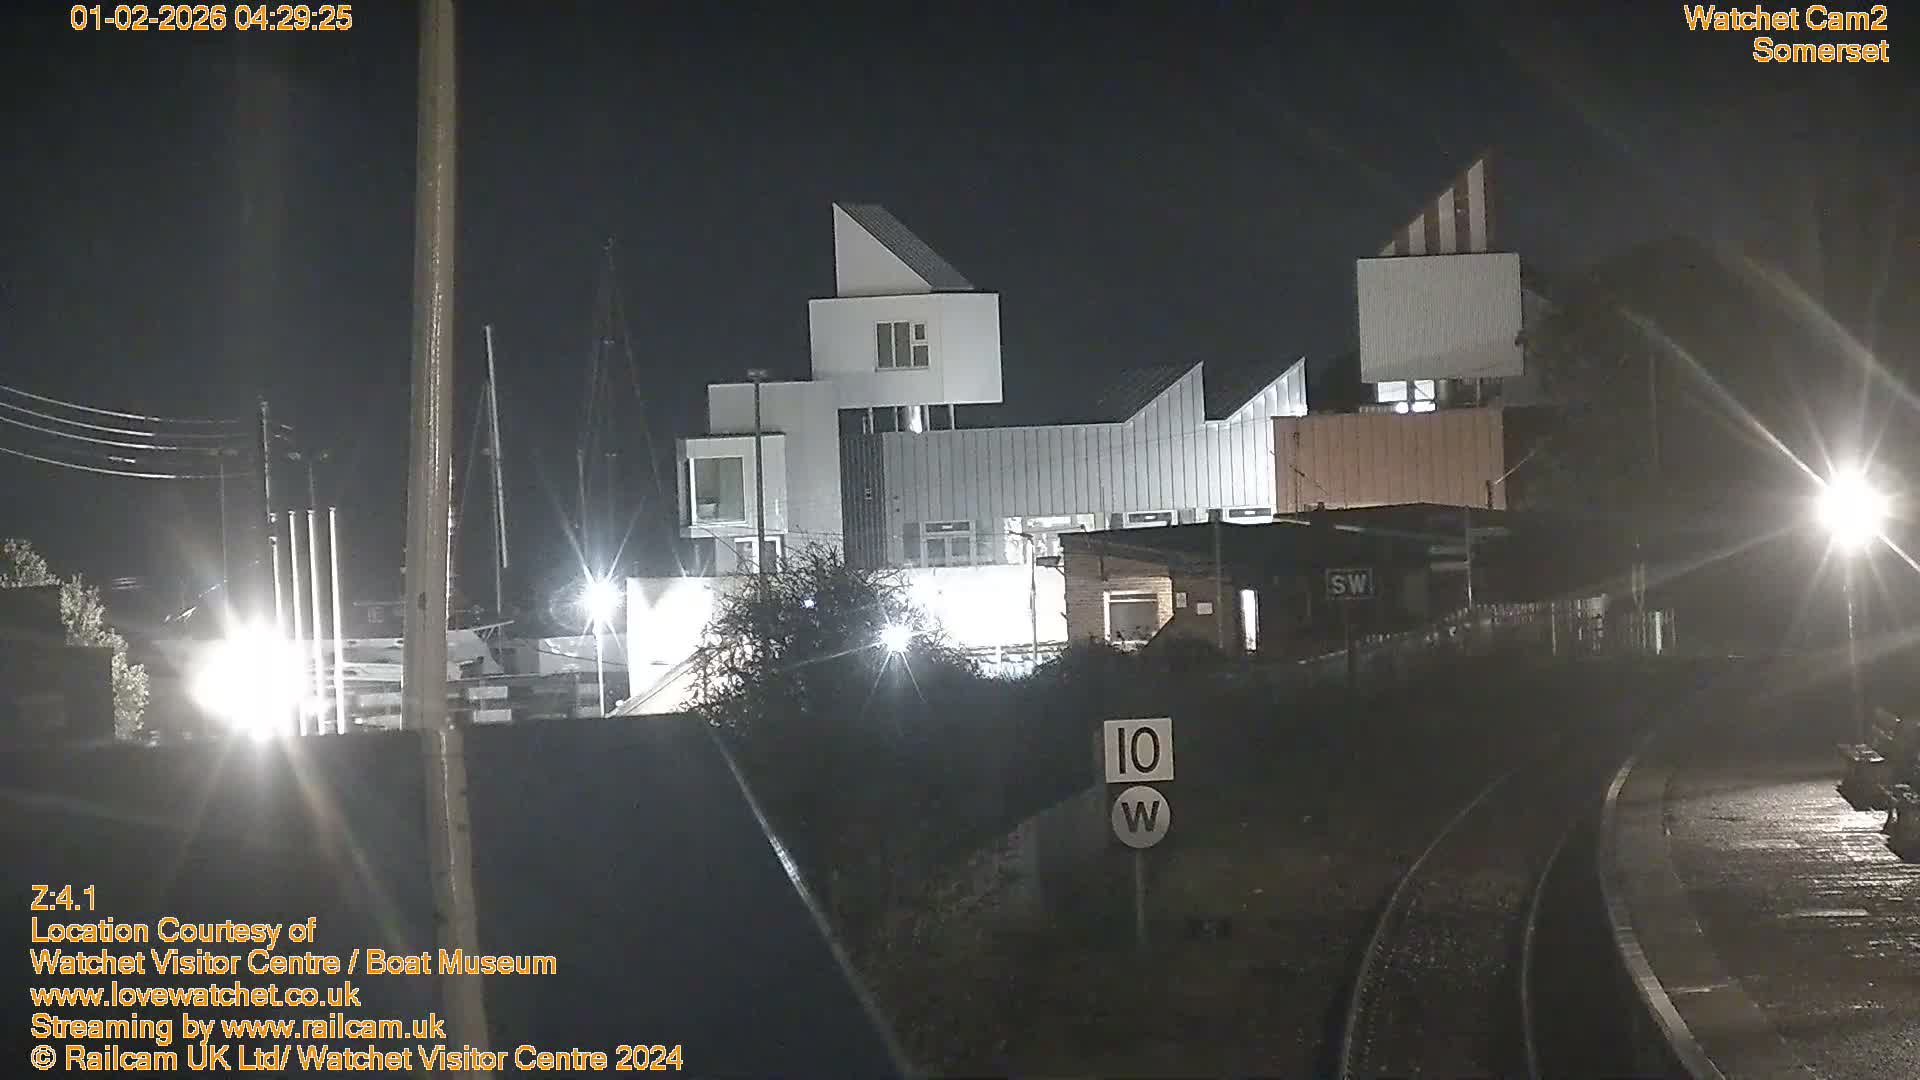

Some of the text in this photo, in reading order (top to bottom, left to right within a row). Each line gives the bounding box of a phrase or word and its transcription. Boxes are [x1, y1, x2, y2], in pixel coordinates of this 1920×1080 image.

[1330, 574, 1369, 595] SW
[1117, 726, 1161, 775] 10
[1121, 800, 1161, 833] W
